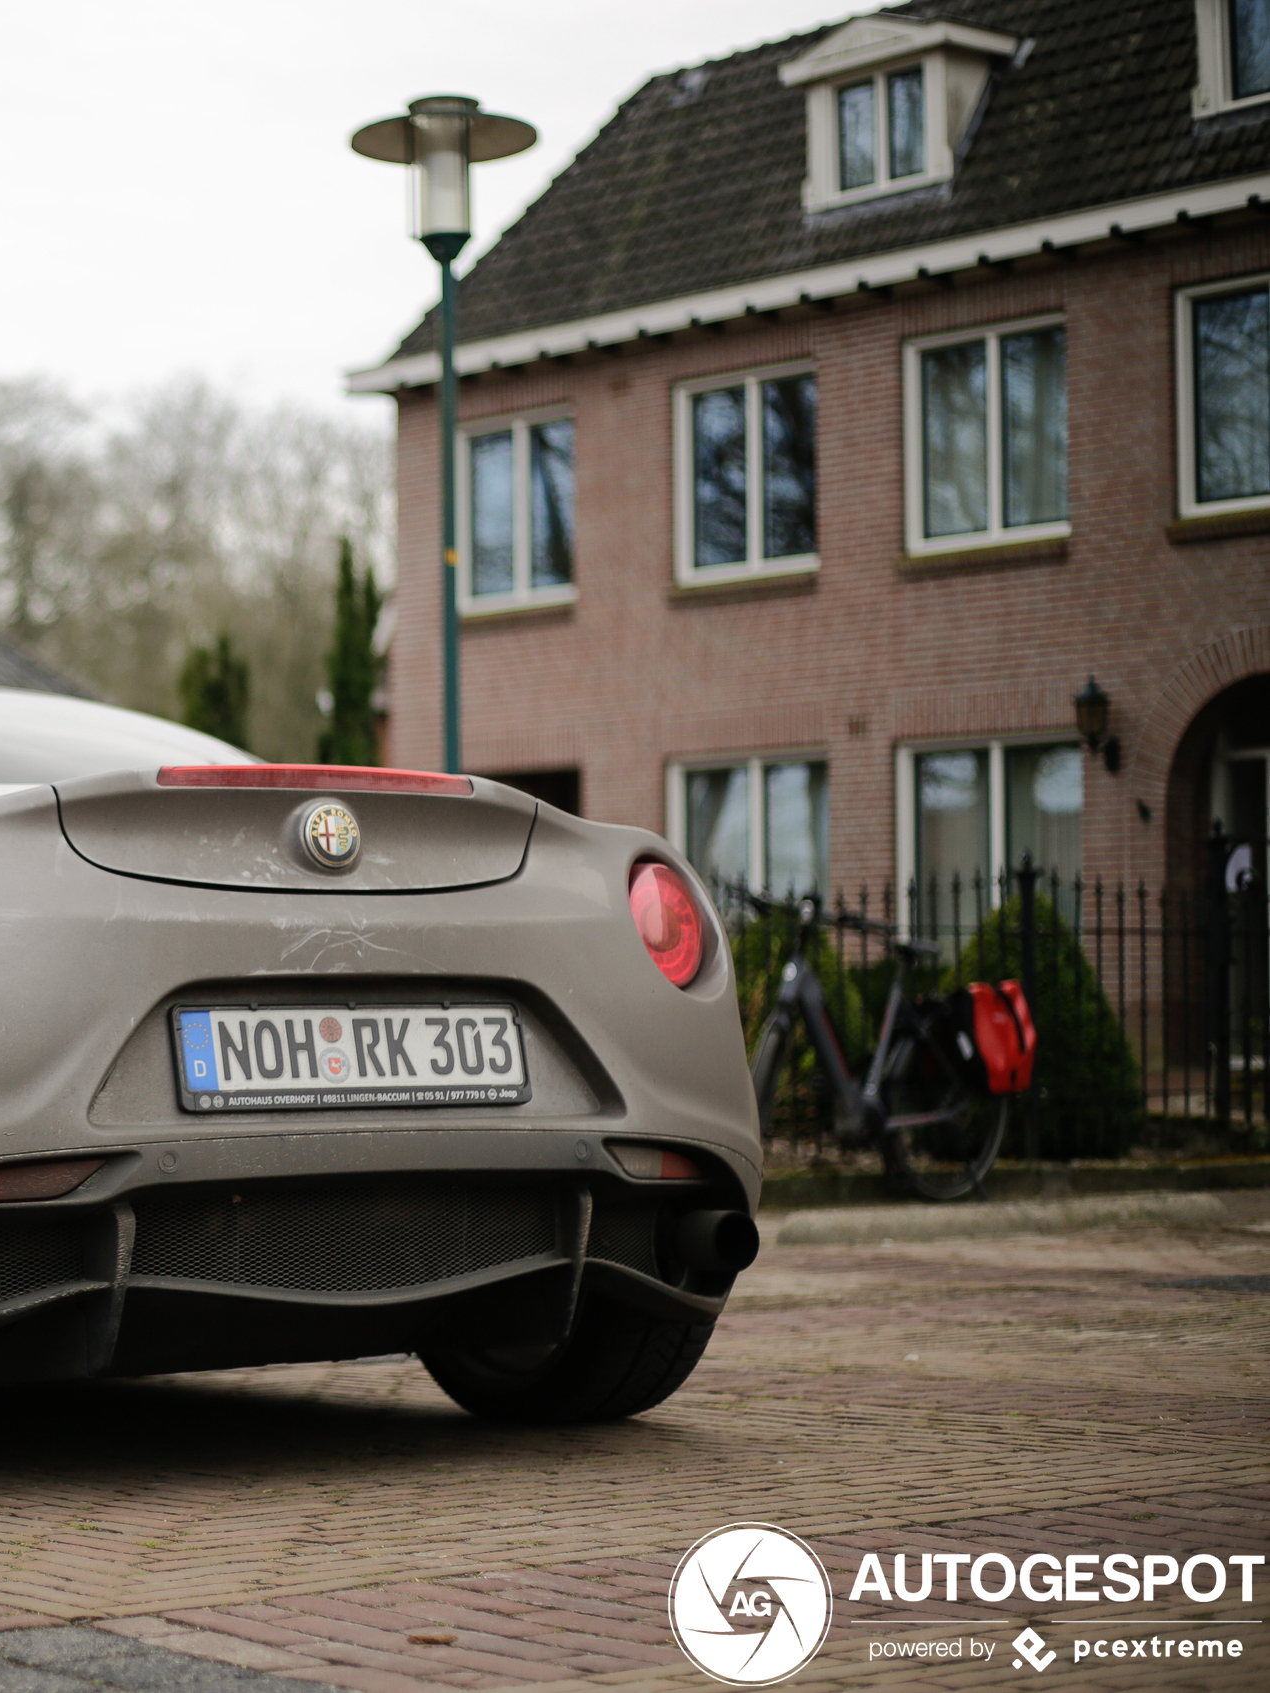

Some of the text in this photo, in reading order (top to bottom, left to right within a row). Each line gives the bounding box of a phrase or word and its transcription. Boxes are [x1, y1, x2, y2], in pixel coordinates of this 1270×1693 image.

[312, 809, 358, 837] ALFA ROMEO
[218, 1019, 319, 1081] NOH
[352, 1017, 417, 1077] RK
[425, 1017, 513, 1076] 303
[194, 1060, 207, 1077] D
[228, 1096, 273, 1106] AUTOHAUS
[274, 1095, 315, 1105] OVERHOFF
[322, 1094, 346, 1104] 49811
[347, 1092, 410, 1103] LINGEN-BACCUM
[499, 1089, 518, 1099] Jeep
